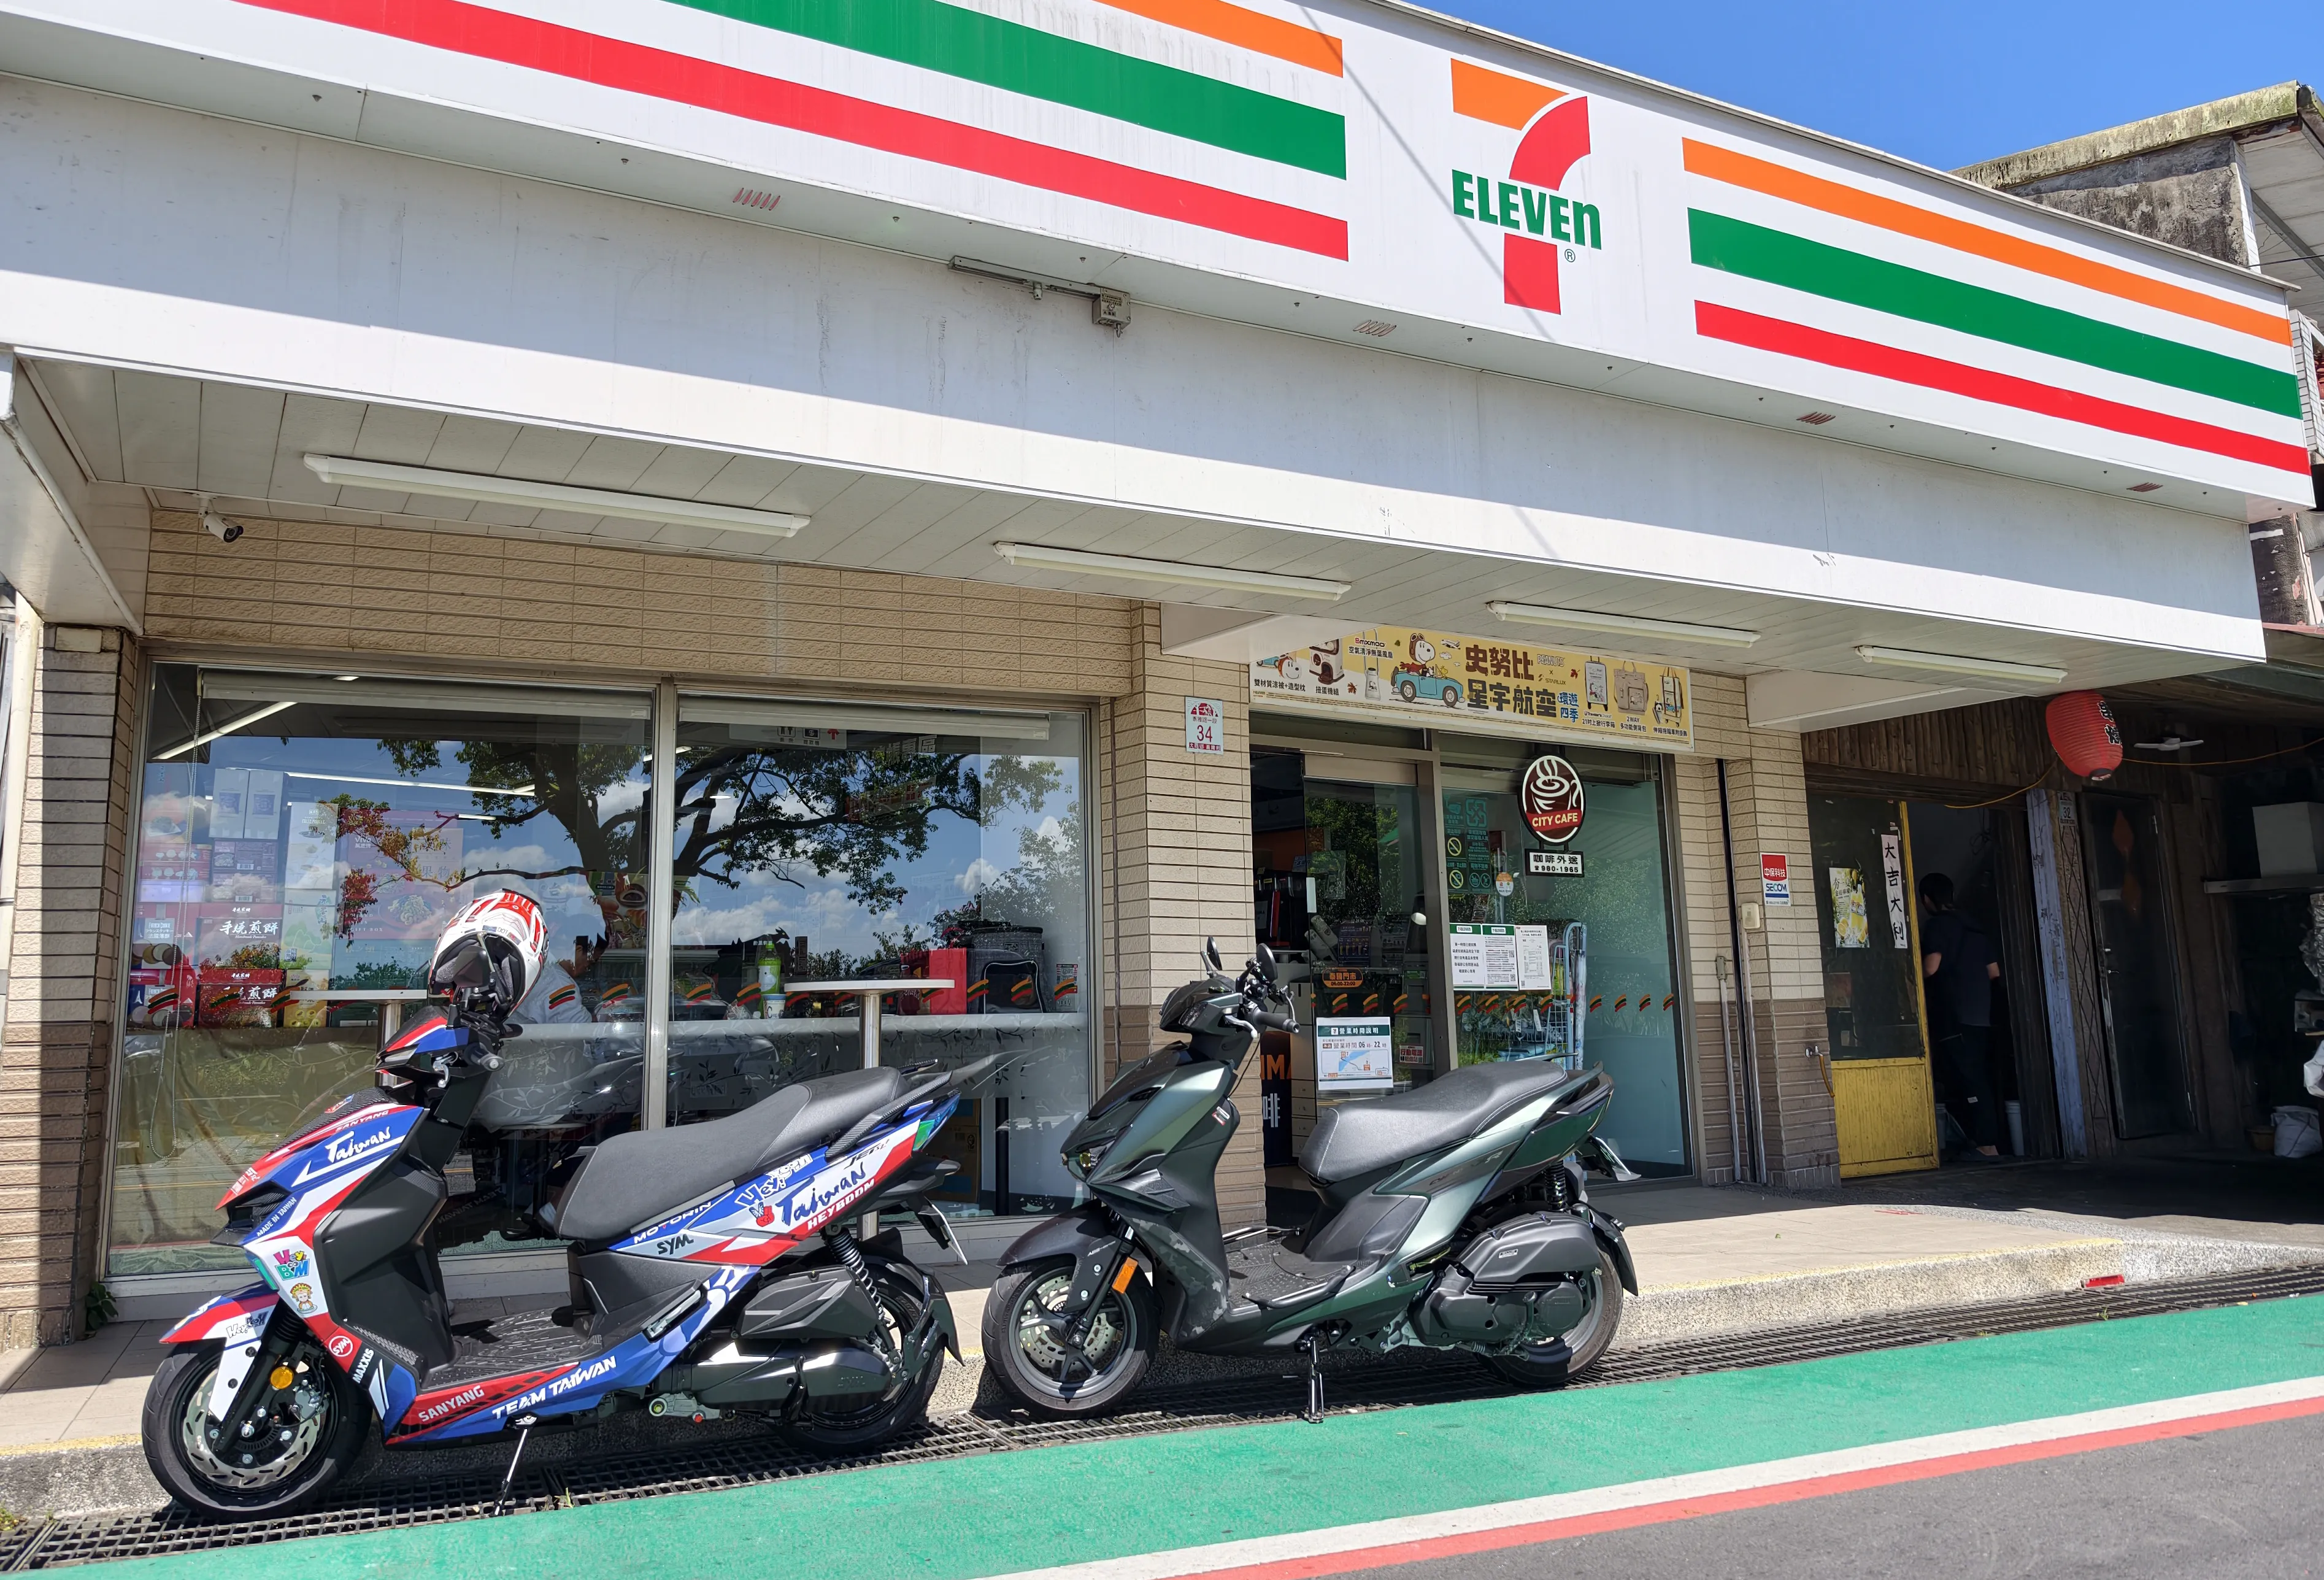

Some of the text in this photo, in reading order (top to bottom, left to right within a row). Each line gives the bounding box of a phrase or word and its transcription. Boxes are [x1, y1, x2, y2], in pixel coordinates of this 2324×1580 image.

[1465, 644, 1534, 681] 史努比
[1537, 653, 1564, 667] PEANUTS
[1315, 686, 1339, 696] 扭蛋機組
[1467, 678, 1557, 718] 星宇航空
[1557, 692, 1579, 707] 環遊
[1560, 707, 1579, 722] 四季
[1196, 725, 1213, 742] 34
[1532, 812, 1578, 827] CITY CAFE
[2063, 807, 2071, 819] 32
[1533, 854, 1579, 865] 咖啡外送
[422, 865, 450, 879] 果物
[1764, 867, 1786, 877] 中保科技
[1766, 883, 1787, 892] SECOM
[1884, 841, 1904, 941] 大吉大利
[335, 1109, 390, 1132] SANYANG
[256, 1197, 297, 1238] MADE IN TAIWAN
[656, 1233, 695, 1255] SYM
[332, 1338, 350, 1355] SYM
[352, 1347, 375, 1384] MAXXIS
[491, 1355, 617, 1420] TEAM TAIWAN
[418, 1385, 485, 1422] SANYANG
